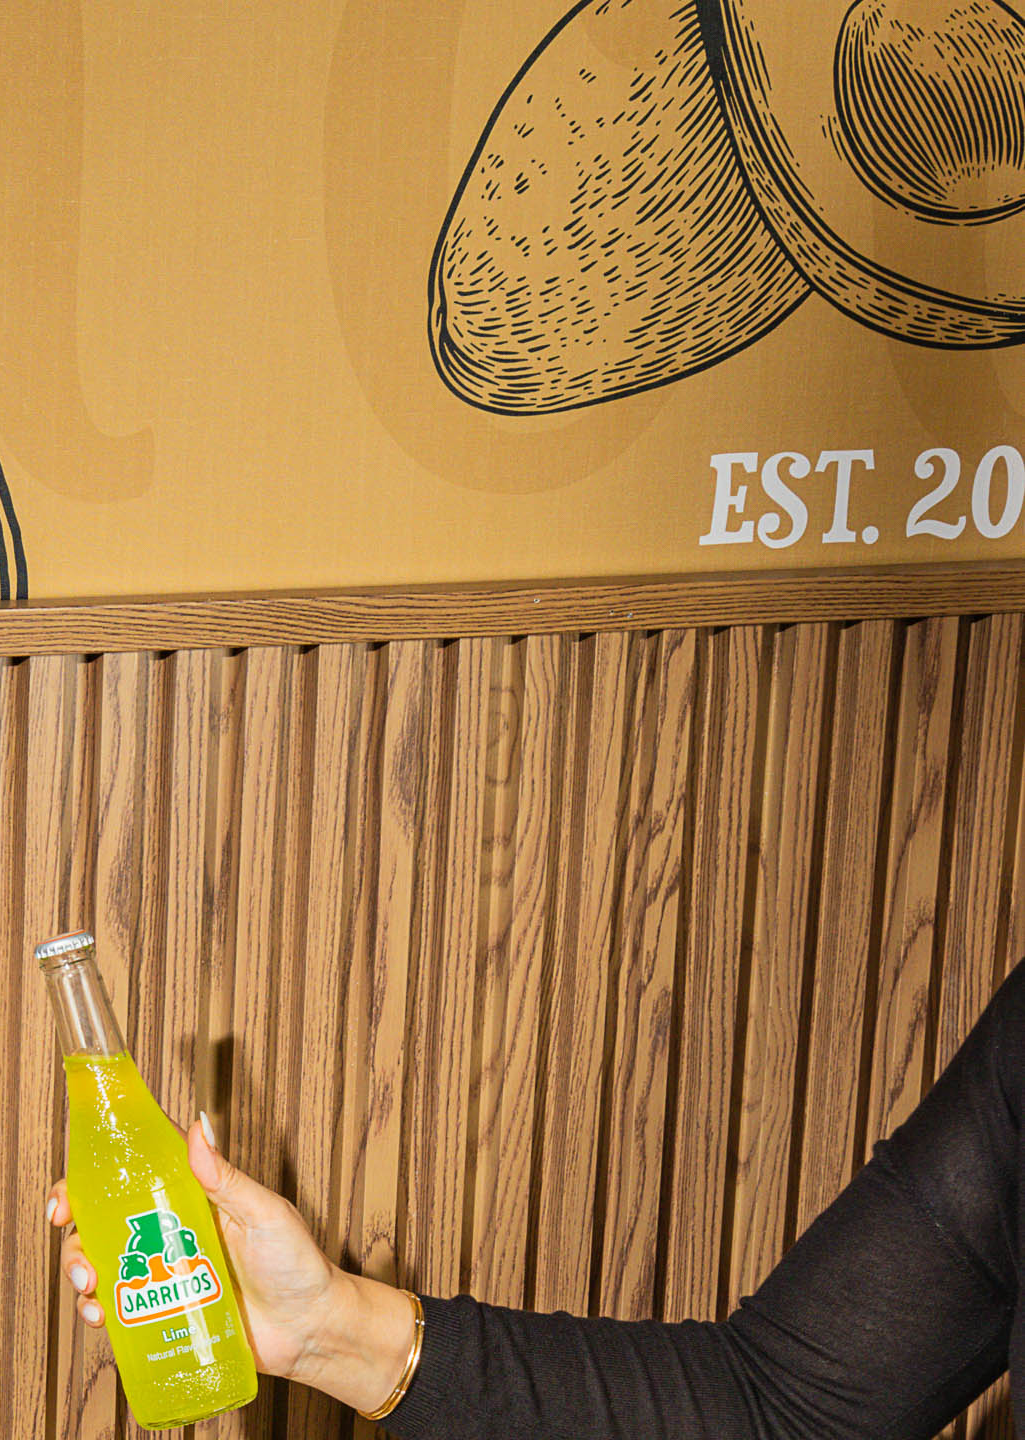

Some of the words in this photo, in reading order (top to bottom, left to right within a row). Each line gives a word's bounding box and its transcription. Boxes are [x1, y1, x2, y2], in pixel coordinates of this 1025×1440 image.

[699, 449, 879, 549] EST.
[906, 445, 1025, 540] 20
[124, 1273, 212, 1312] JARRITOS
[163, 1326, 197, 1342] Lime
[147, 1349, 176, 1362] Natural
